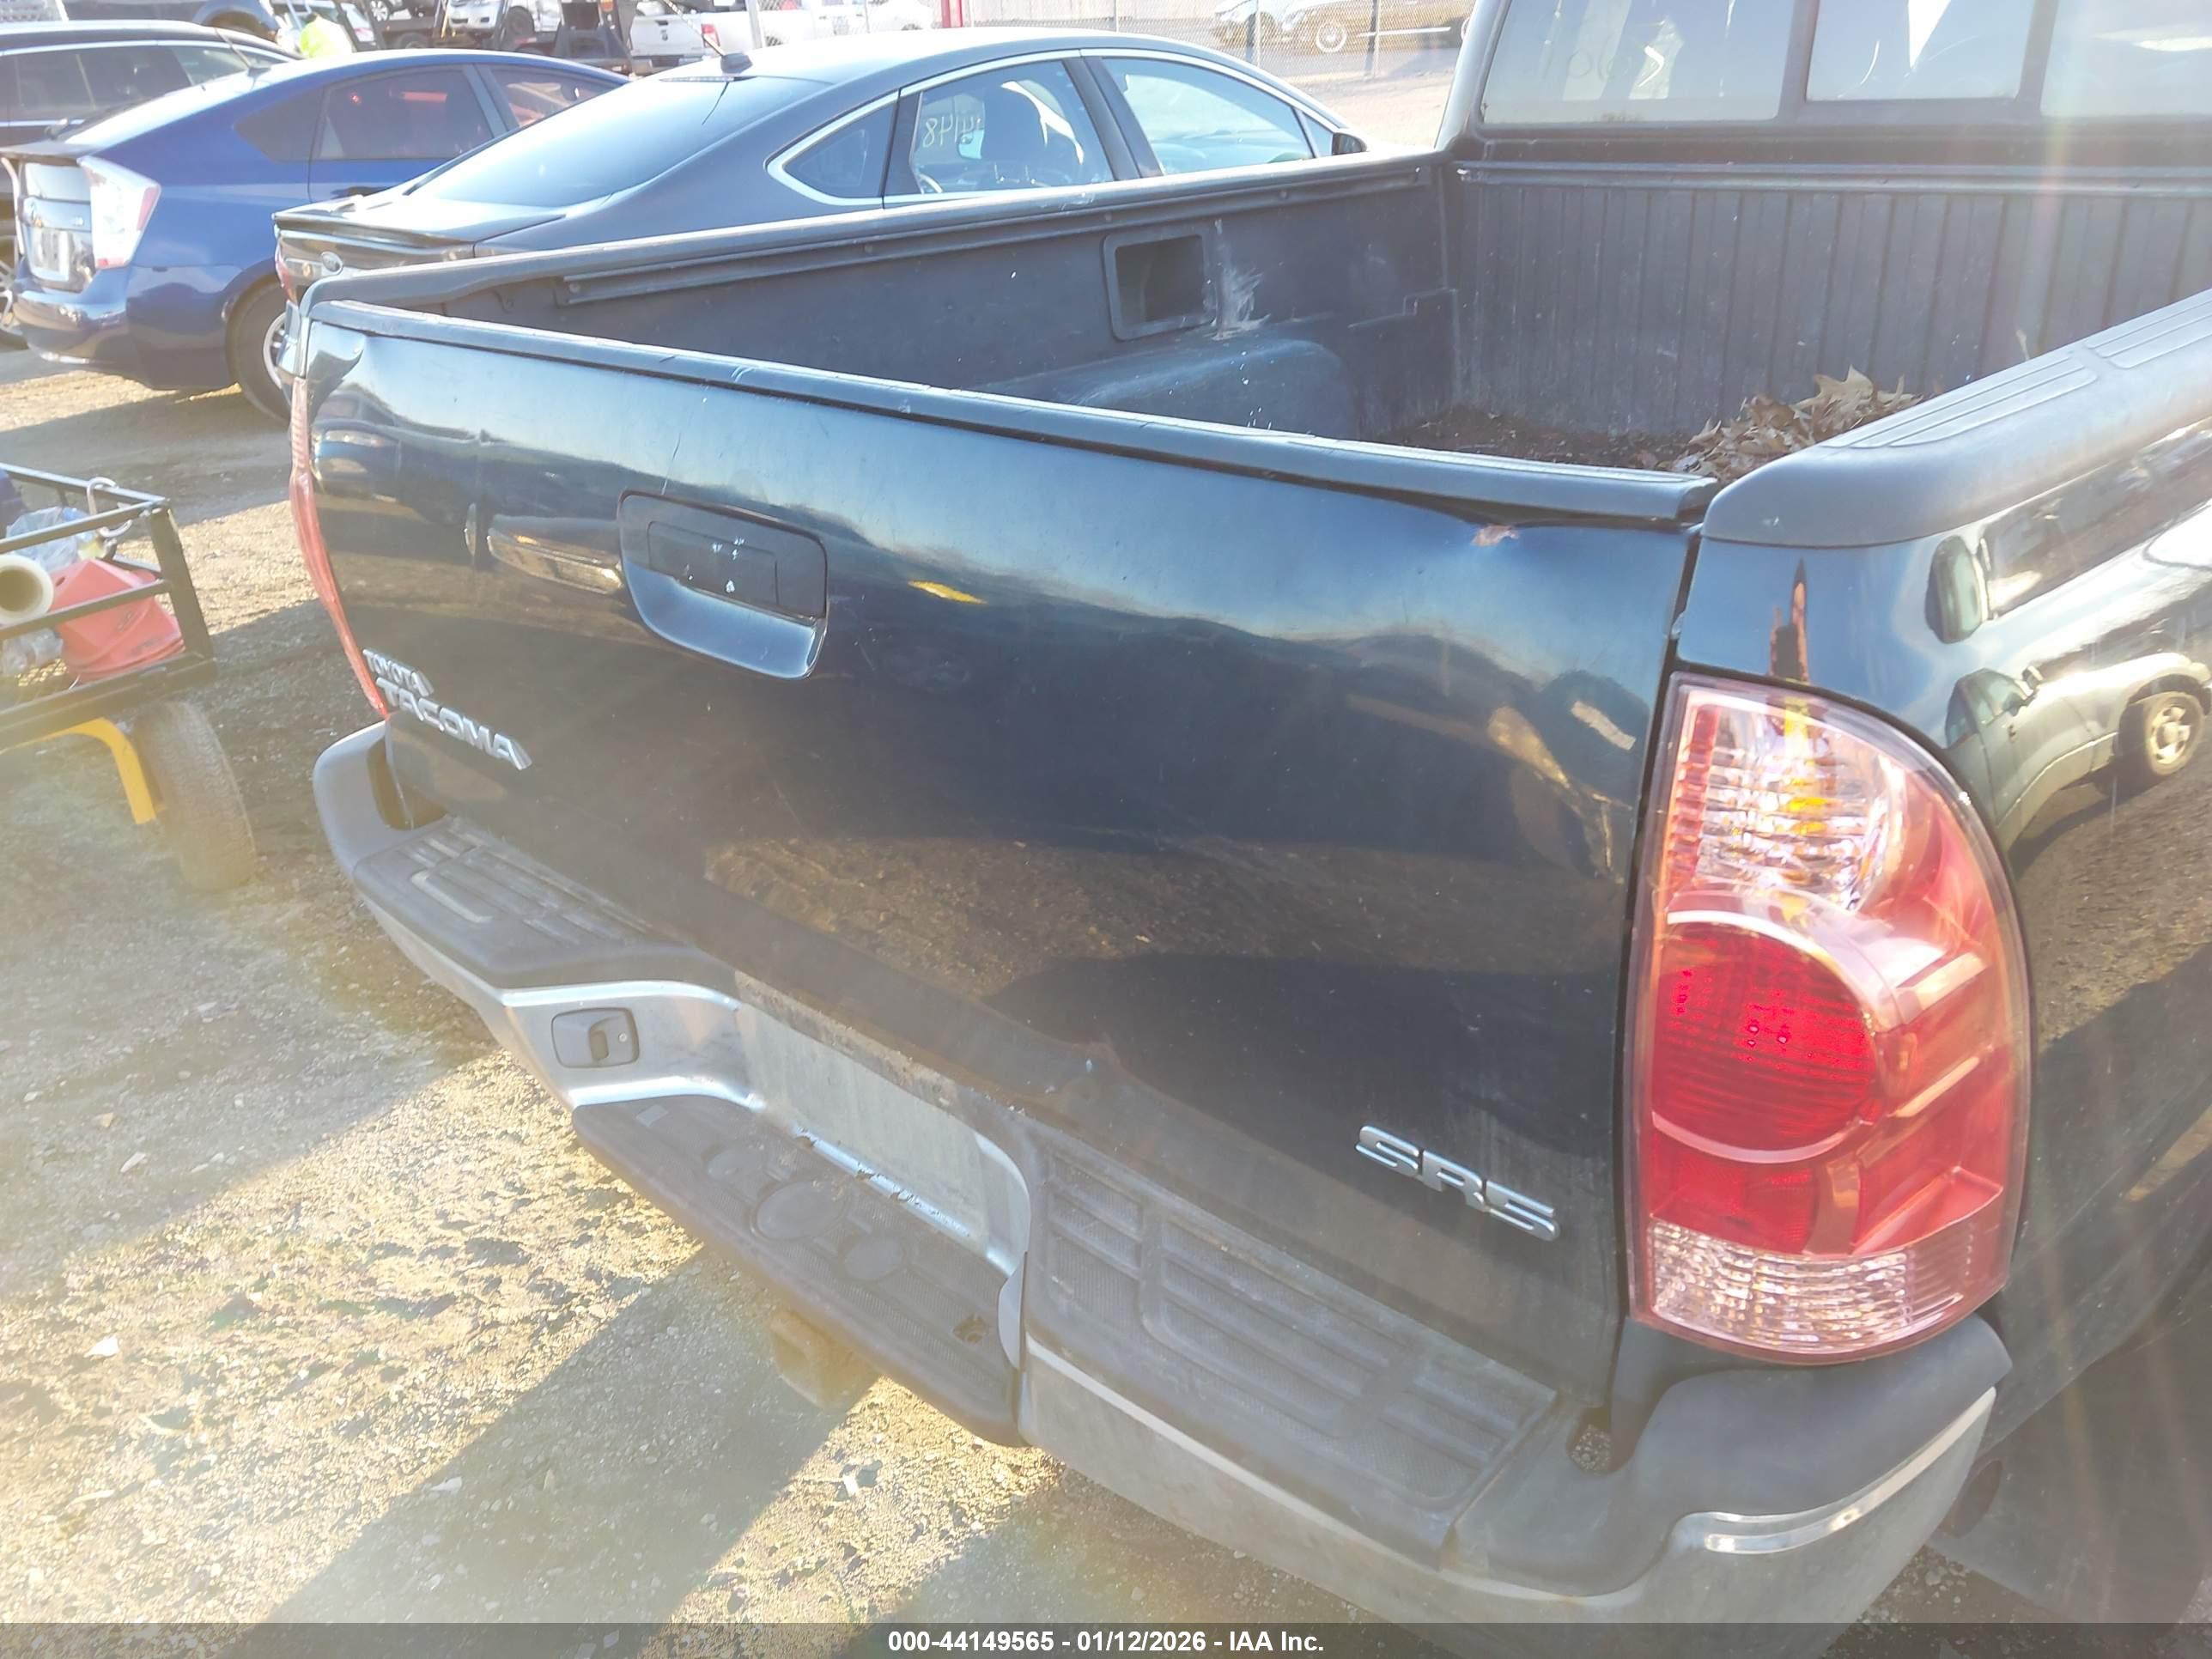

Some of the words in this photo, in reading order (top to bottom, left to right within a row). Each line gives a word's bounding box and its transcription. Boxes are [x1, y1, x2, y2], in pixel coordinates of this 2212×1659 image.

[362, 648, 434, 697] TOYOTA
[376, 677, 532, 770] TACOMA
[1355, 1125, 1560, 1242] SR5
